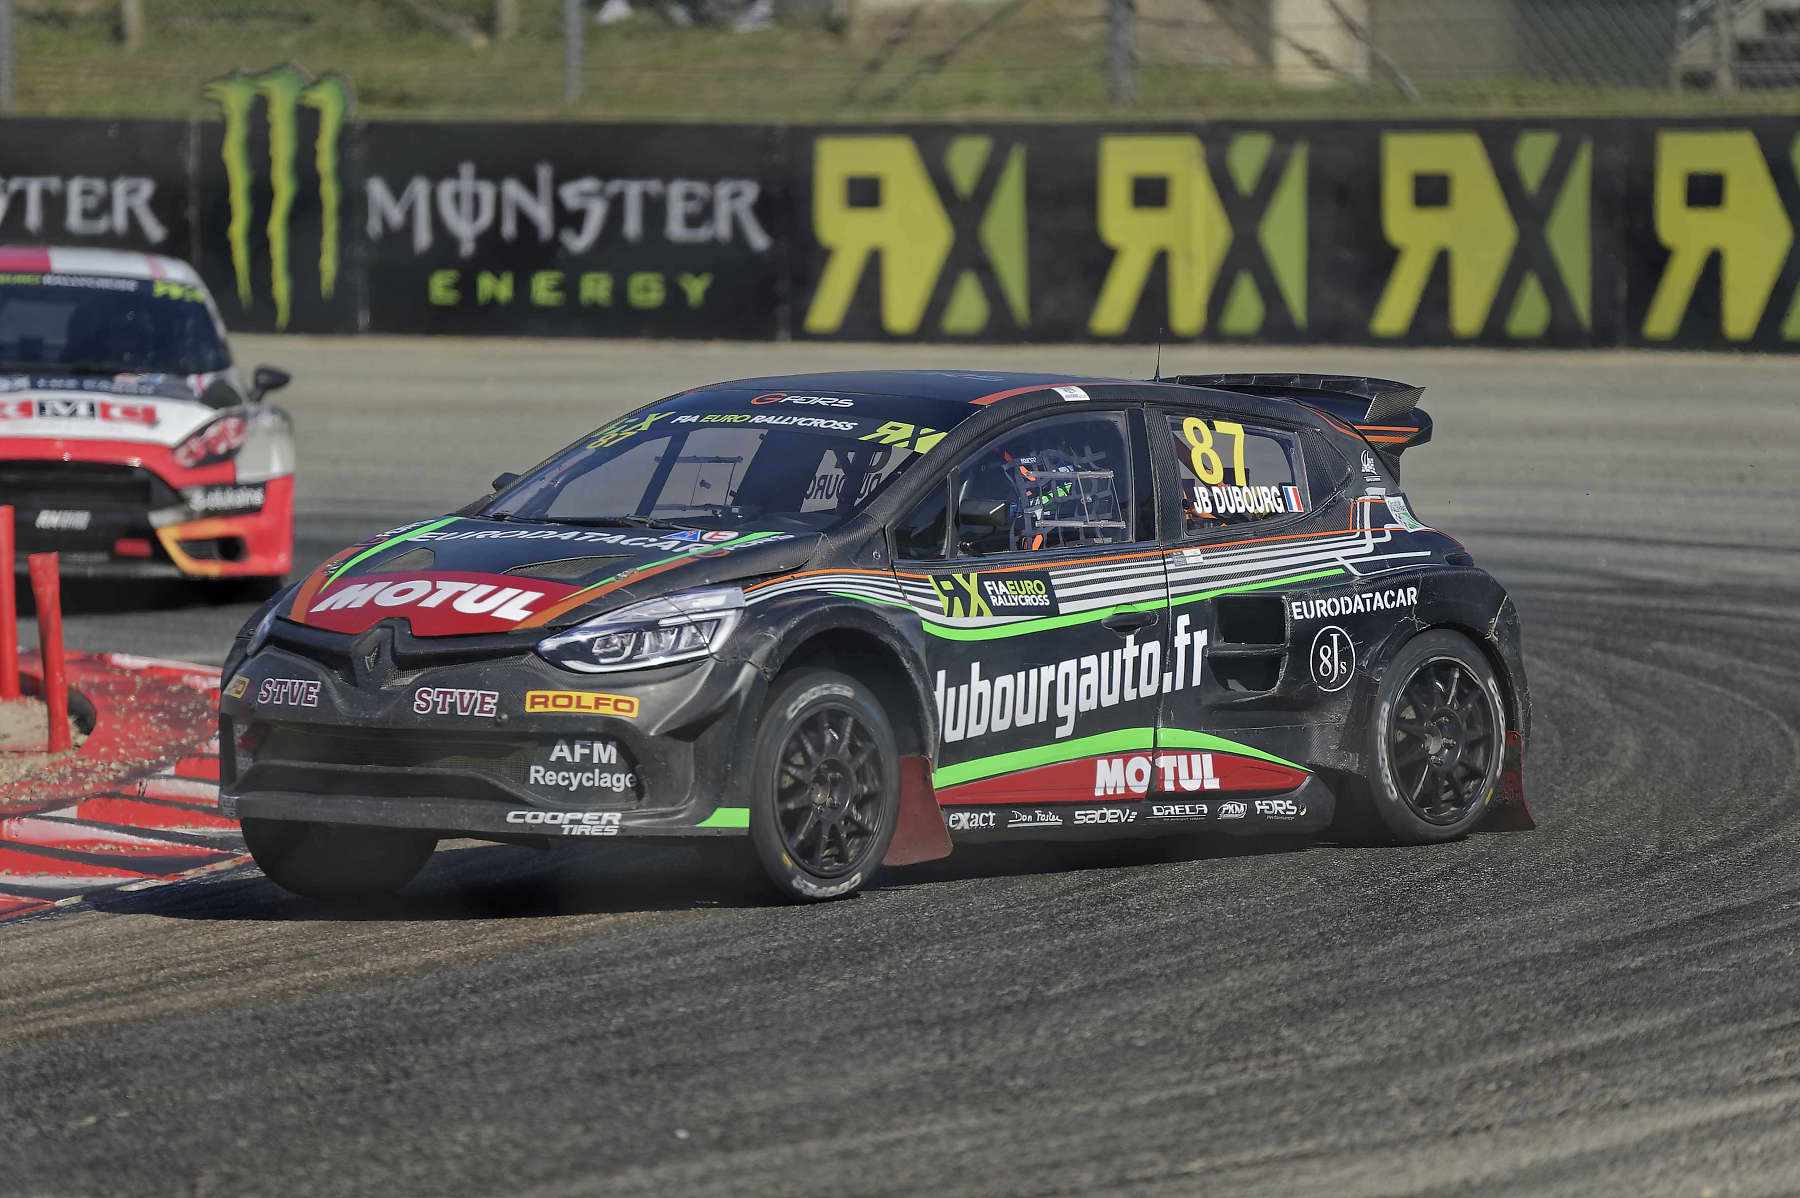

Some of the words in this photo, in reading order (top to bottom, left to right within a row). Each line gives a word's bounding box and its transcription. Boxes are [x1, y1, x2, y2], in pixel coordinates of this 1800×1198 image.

[366, 162, 772, 258] MONSTER
[428, 270, 712, 307] ENERGY
[670, 415, 700, 424] FIA
[699, 415, 751, 423] EURO
[749, 415, 858, 431] RALLYCROSS
[1182, 417, 1247, 487] 87
[1193, 486, 1212, 514] JB
[1212, 485, 1286, 514] DUBOURG
[309, 580, 545, 621] MOTUL
[991, 594, 1051, 606] RALLYCROSS
[1291, 587, 1418, 620] EURODATACAR
[258, 678, 321, 707] STVE
[413, 687, 499, 717] STVE
[529, 694, 635, 713] ROLFO
[549, 739, 618, 764] AFM
[529, 765, 637, 793] Recyclage
[1094, 753, 1220, 796] MOTUL
[506, 811, 622, 826] COOPER
[561, 824, 619, 836] TIRES
[949, 811, 997, 830] exact
